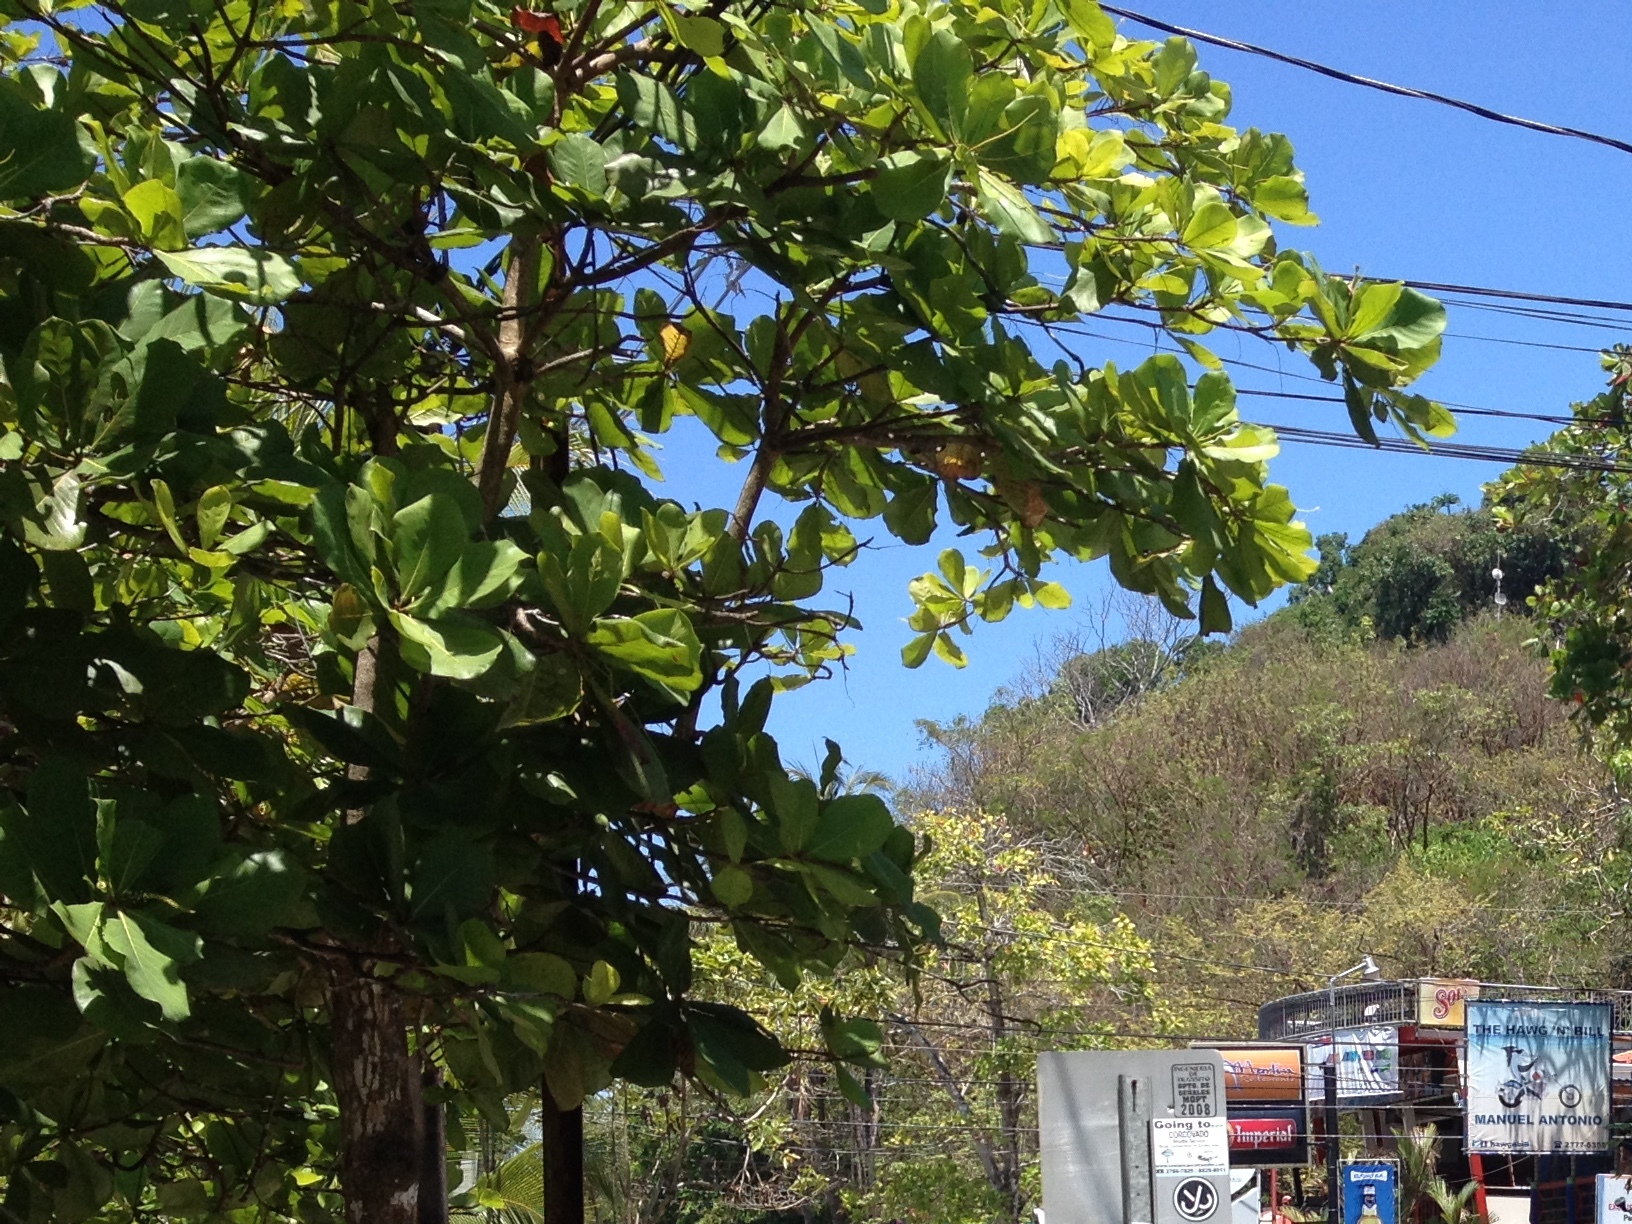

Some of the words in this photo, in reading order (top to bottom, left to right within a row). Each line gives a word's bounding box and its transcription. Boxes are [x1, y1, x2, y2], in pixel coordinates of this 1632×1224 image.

[1473, 1024, 1501, 1036] THE
[1506, 1024, 1548, 1037] HAWG
[1574, 1025, 1604, 1038] BILL
[1182, 1095, 1207, 1103] MOPT
[1181, 1103, 1211, 1116] 2008
[1154, 1120, 1193, 1130] Going
[1474, 1114, 1534, 1126] MANUEL
[1539, 1114, 1603, 1127] ANTONIO
[1234, 1124, 1293, 1150] Imperial
